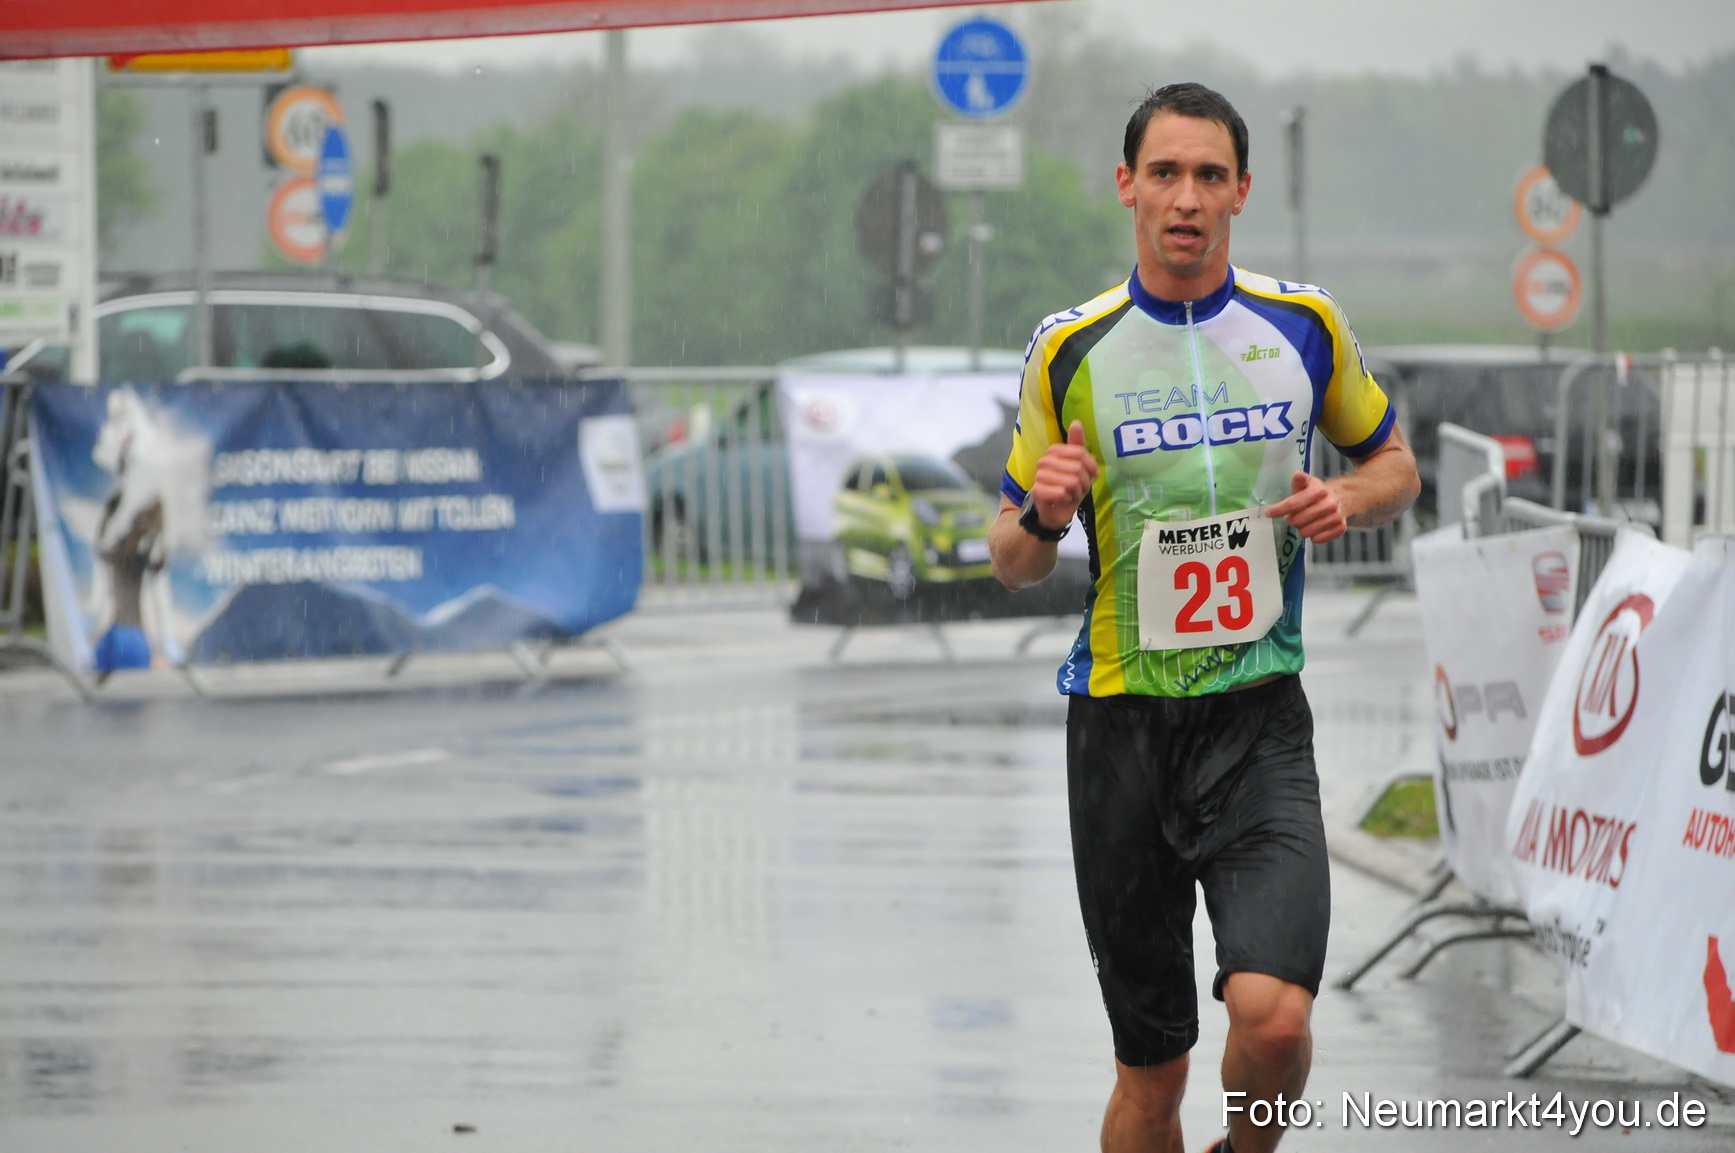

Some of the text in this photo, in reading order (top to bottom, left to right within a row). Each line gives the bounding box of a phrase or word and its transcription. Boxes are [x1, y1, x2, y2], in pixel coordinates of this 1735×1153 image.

[1114, 380, 1229, 415] TEAM
[1113, 400, 1294, 458] BOCK
[1158, 523, 1222, 545] MEYER
[1158, 538, 1225, 556] WERBUNG
[1174, 555, 1254, 634] 23
